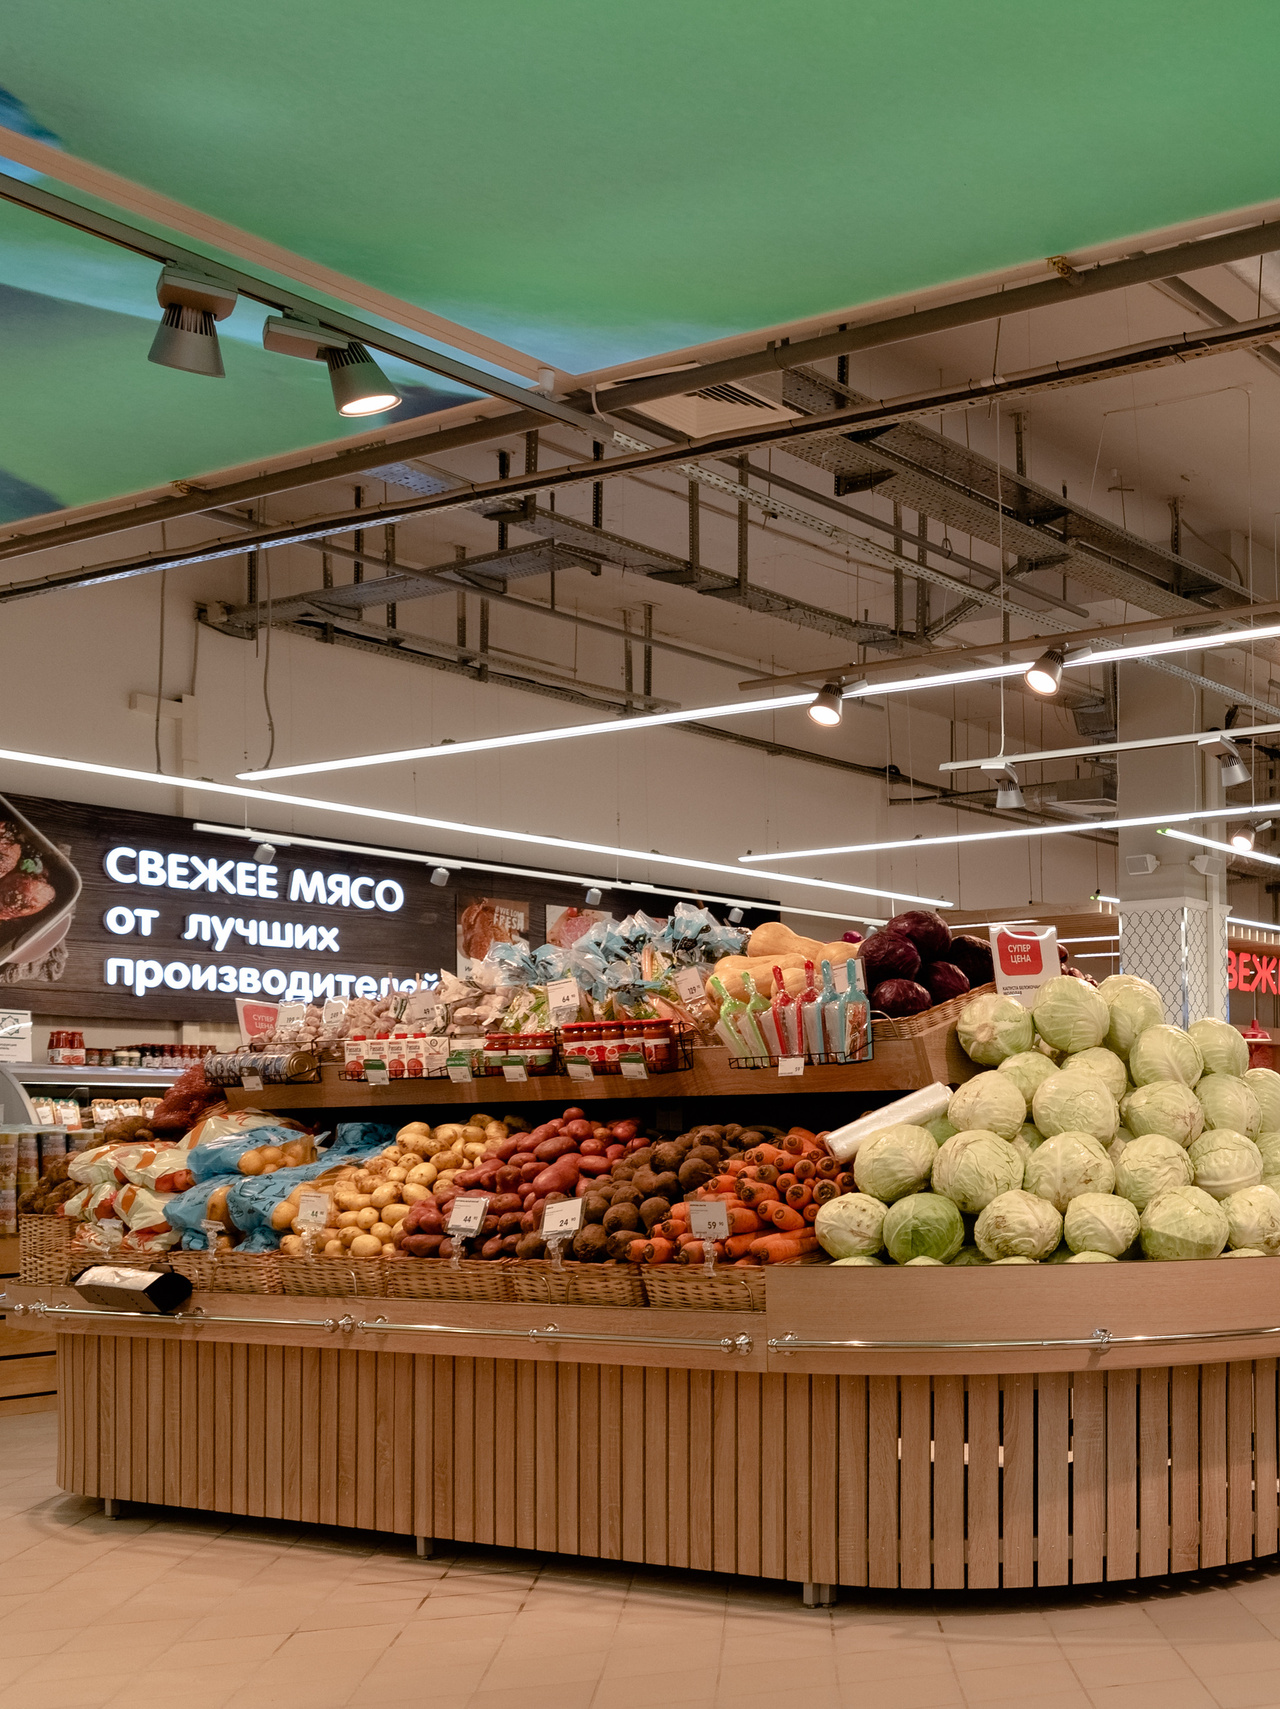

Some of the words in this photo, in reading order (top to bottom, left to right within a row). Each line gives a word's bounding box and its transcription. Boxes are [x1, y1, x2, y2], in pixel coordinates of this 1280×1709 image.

[104, 846, 279, 900] СВЕЖЕЕ
[289, 868, 405, 913] МЯСО
[493, 913, 524, 931] FRESH
[104, 906, 160, 937] от
[183, 912, 340, 953] лучших
[1008, 944, 1031, 953] СУПЕР
[1010, 954, 1032, 964] ЦЕНА
[688, 986, 697, 995] 129
[252, 1014, 275, 1023] СУПЕР
[254, 1021, 275, 1030] ЦЕНА
[310, 1210, 318, 1218] 44
[463, 1215, 472, 1223] 44
[559, 1219, 569, 1227] 24
[708, 1221, 717, 1229] 59
